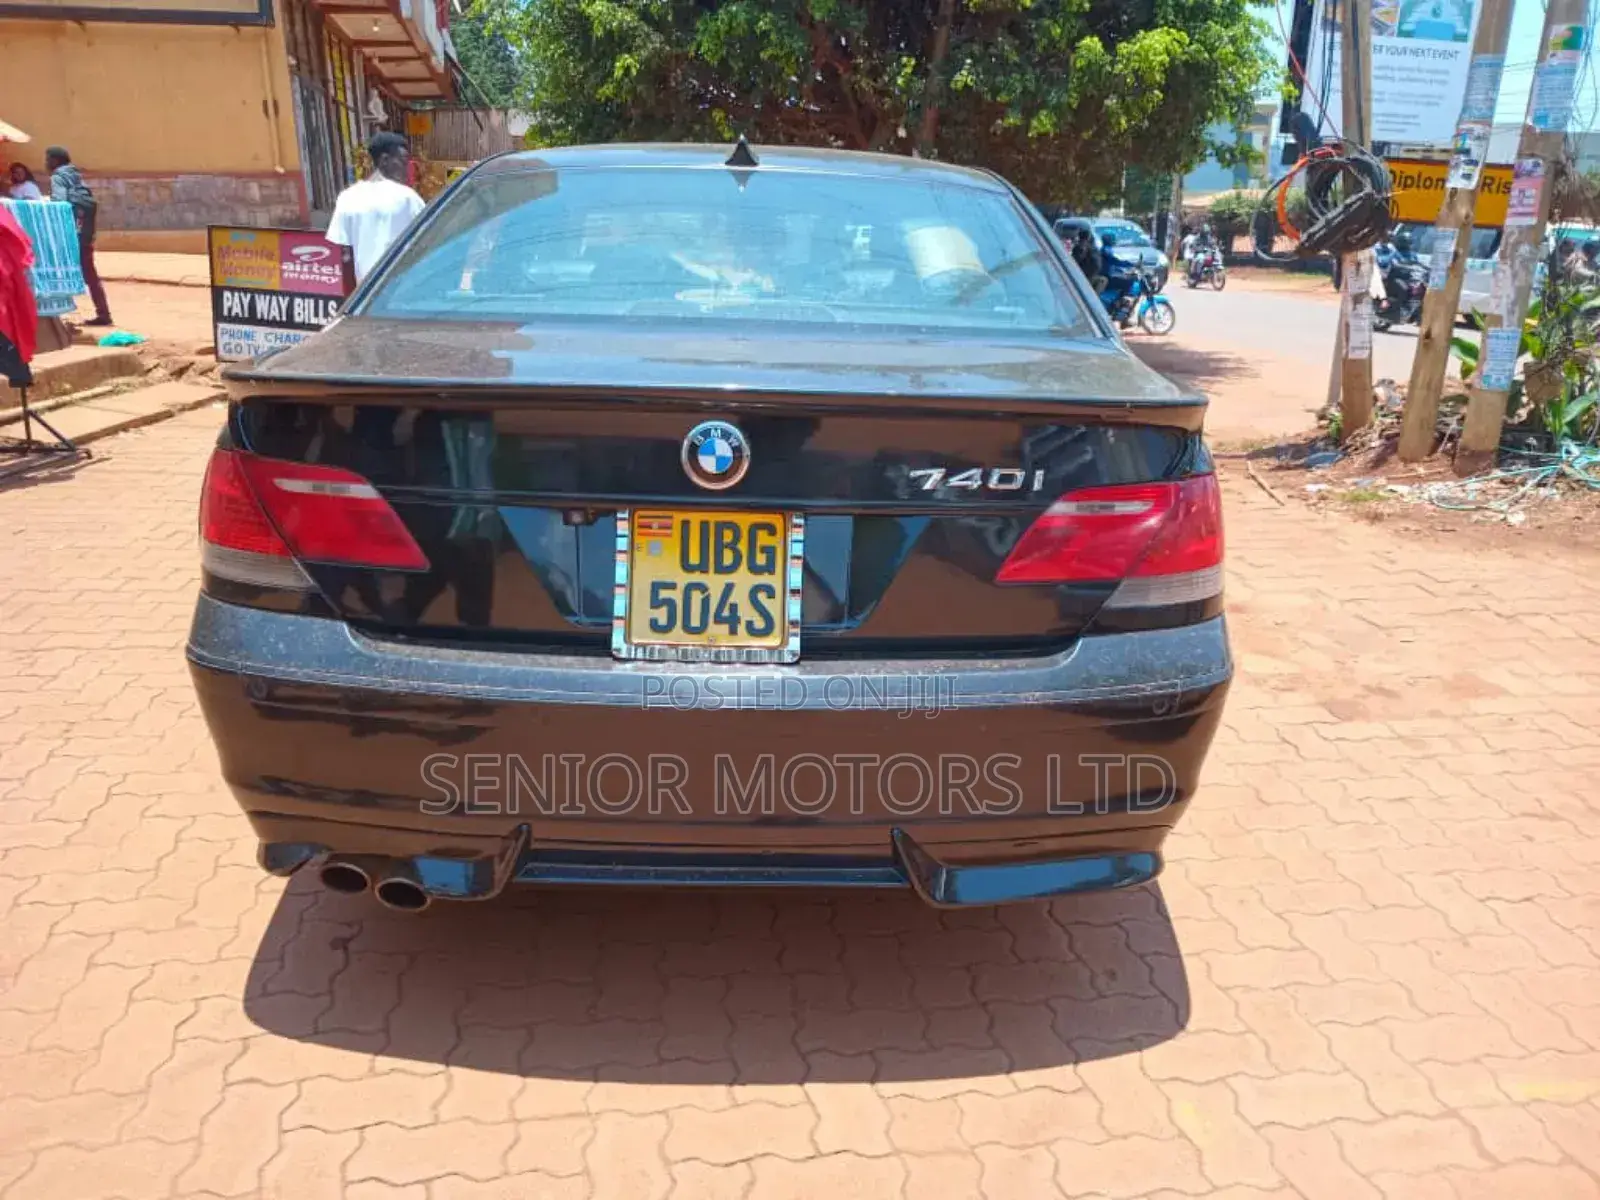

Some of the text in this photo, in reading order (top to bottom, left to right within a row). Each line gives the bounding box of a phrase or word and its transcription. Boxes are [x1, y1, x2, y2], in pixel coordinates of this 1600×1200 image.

[1386, 44, 1409, 56] YOUR
[1409, 47, 1433, 59] NEXT
[1433, 48, 1461, 61] EVENT
[216, 244, 275, 262] Mobile
[219, 261, 276, 279] Money
[281, 260, 343, 276] airtel
[282, 271, 339, 284] money
[222, 290, 338, 325] PAY WAY BILLS
[220, 327, 257, 342] PHONE
[692, 426, 740, 448] BMW
[680, 519, 777, 576] UBG
[649, 580, 776, 637] 504S
